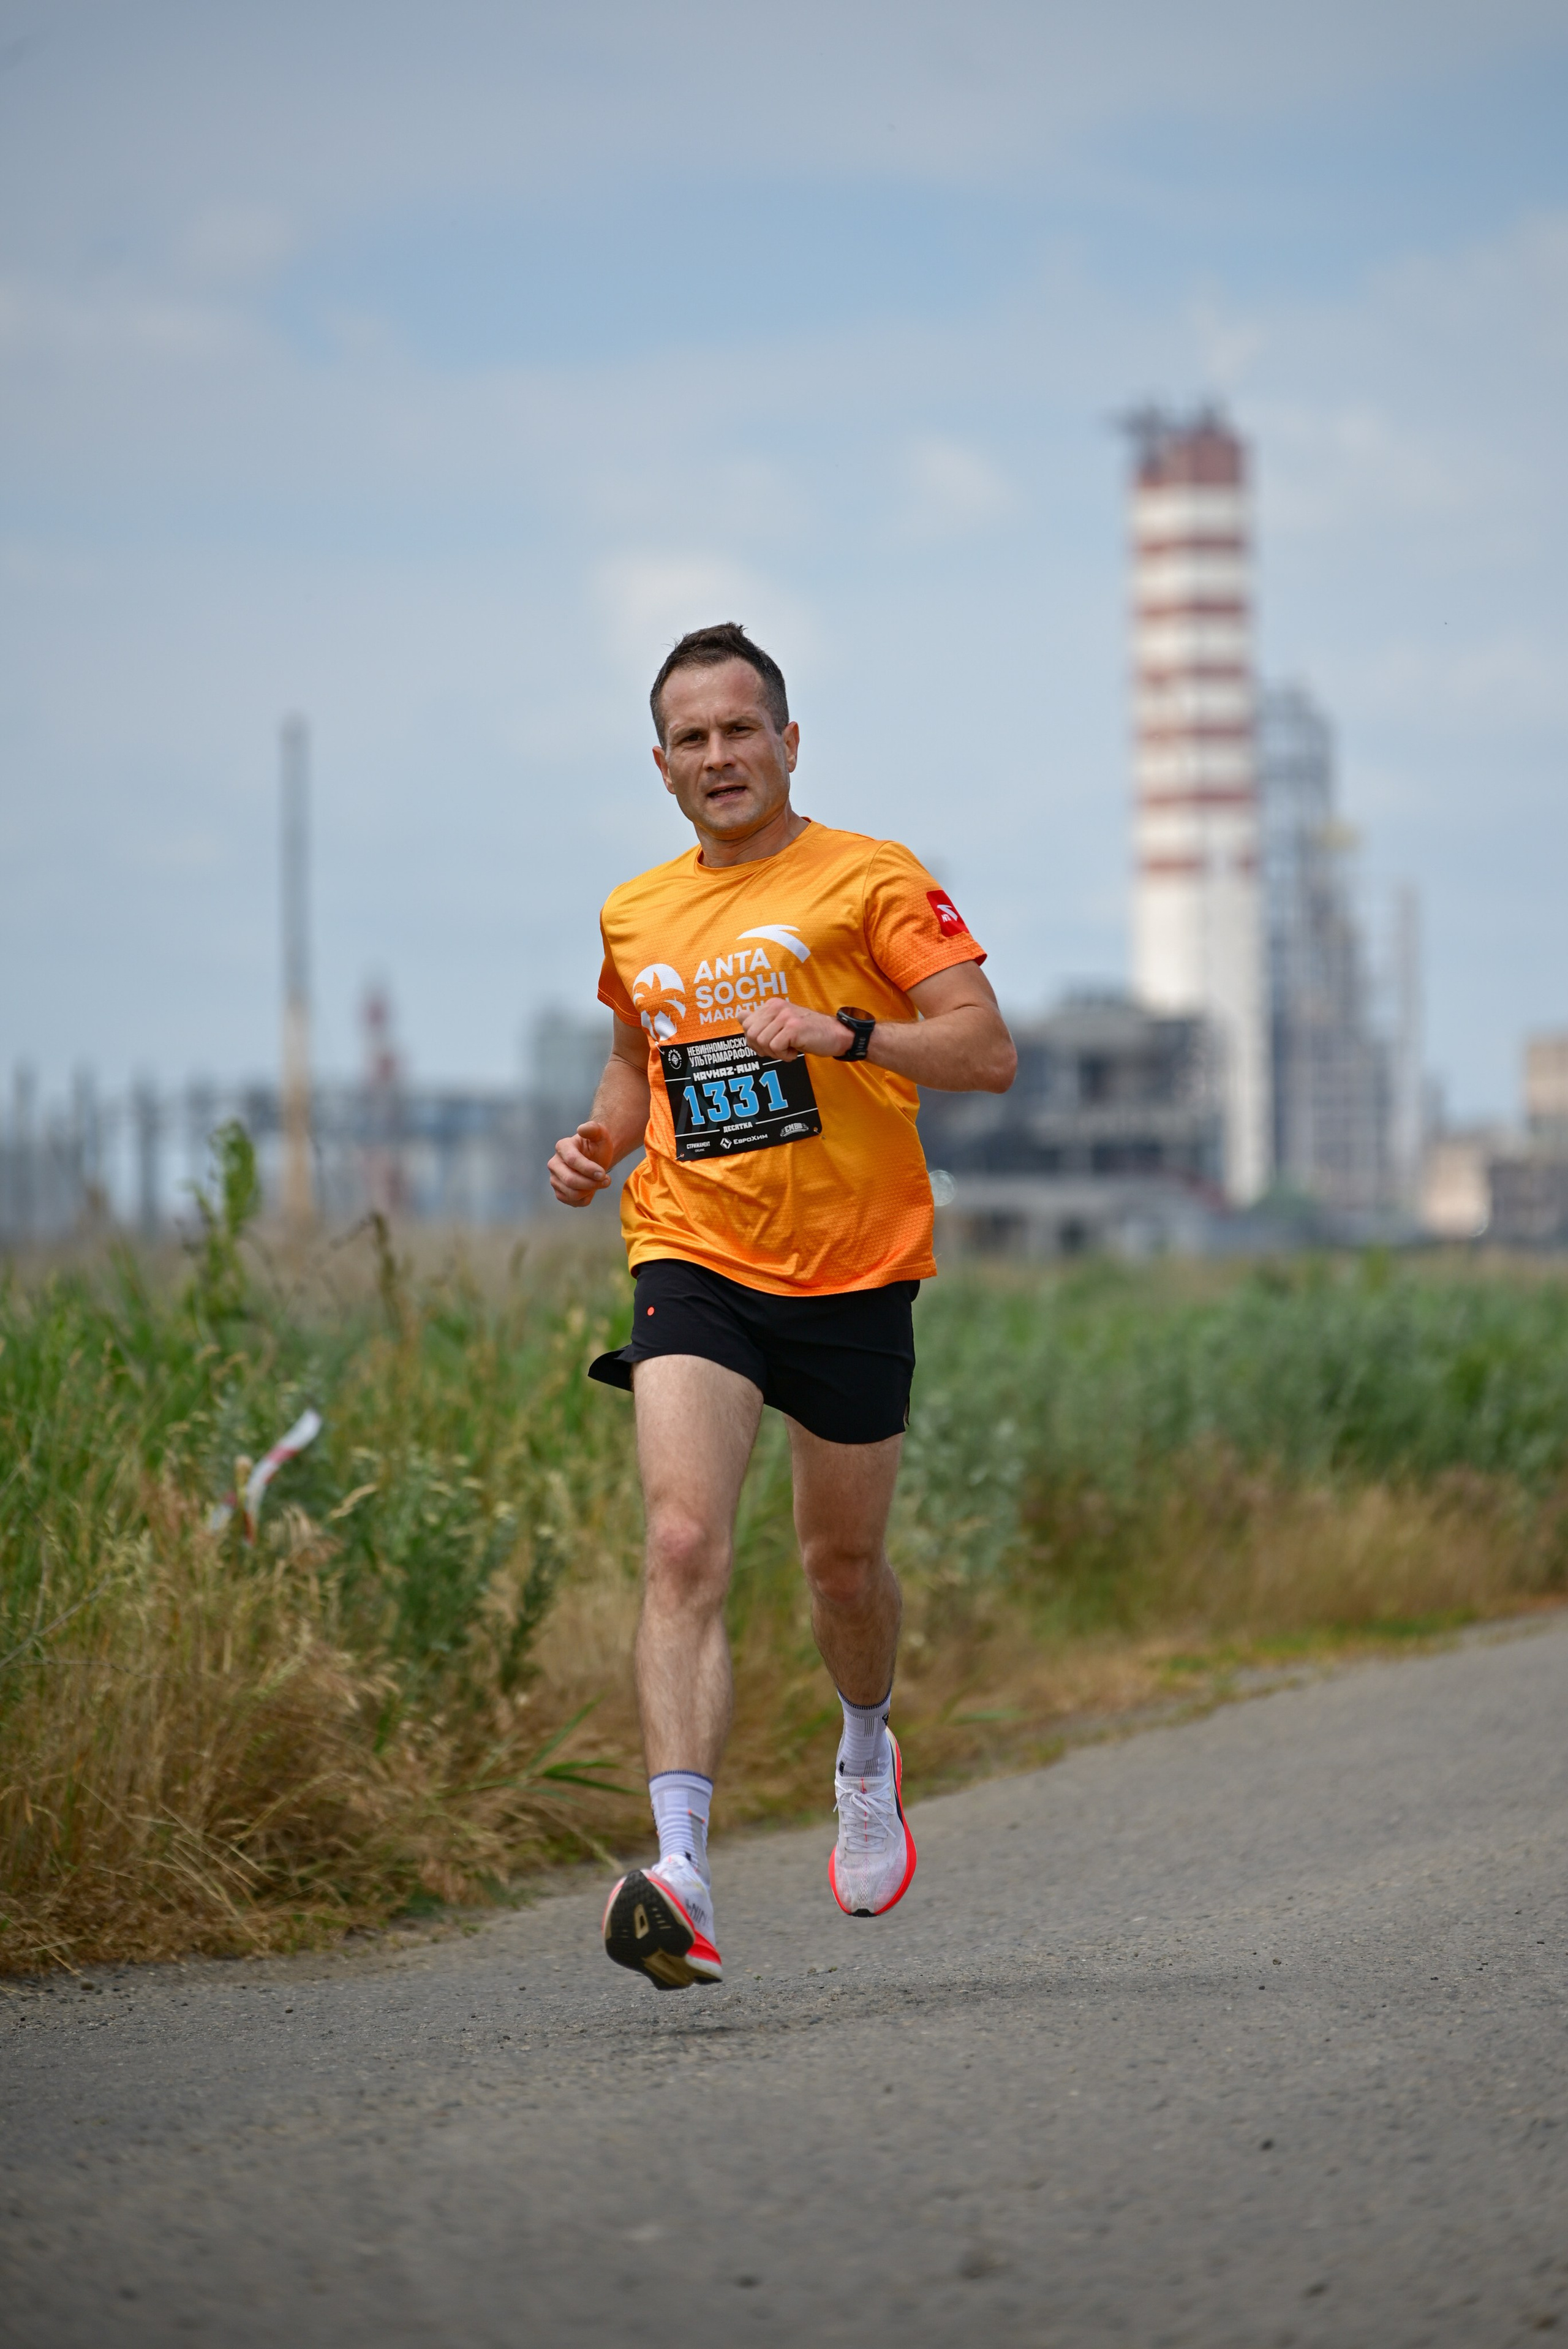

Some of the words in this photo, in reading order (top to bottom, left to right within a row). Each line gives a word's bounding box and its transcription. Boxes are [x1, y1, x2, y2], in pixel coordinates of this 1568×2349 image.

[693, 948, 772, 984] ANTA
[695, 971, 788, 1009] SOCHI
[699, 997, 790, 1025] MARATH
[687, 1037, 747, 1057] НЕВИННОМЫССКИ
[683, 1070, 788, 1125] 1331
[723, 1121, 753, 1133] ДЕСЯТКА
